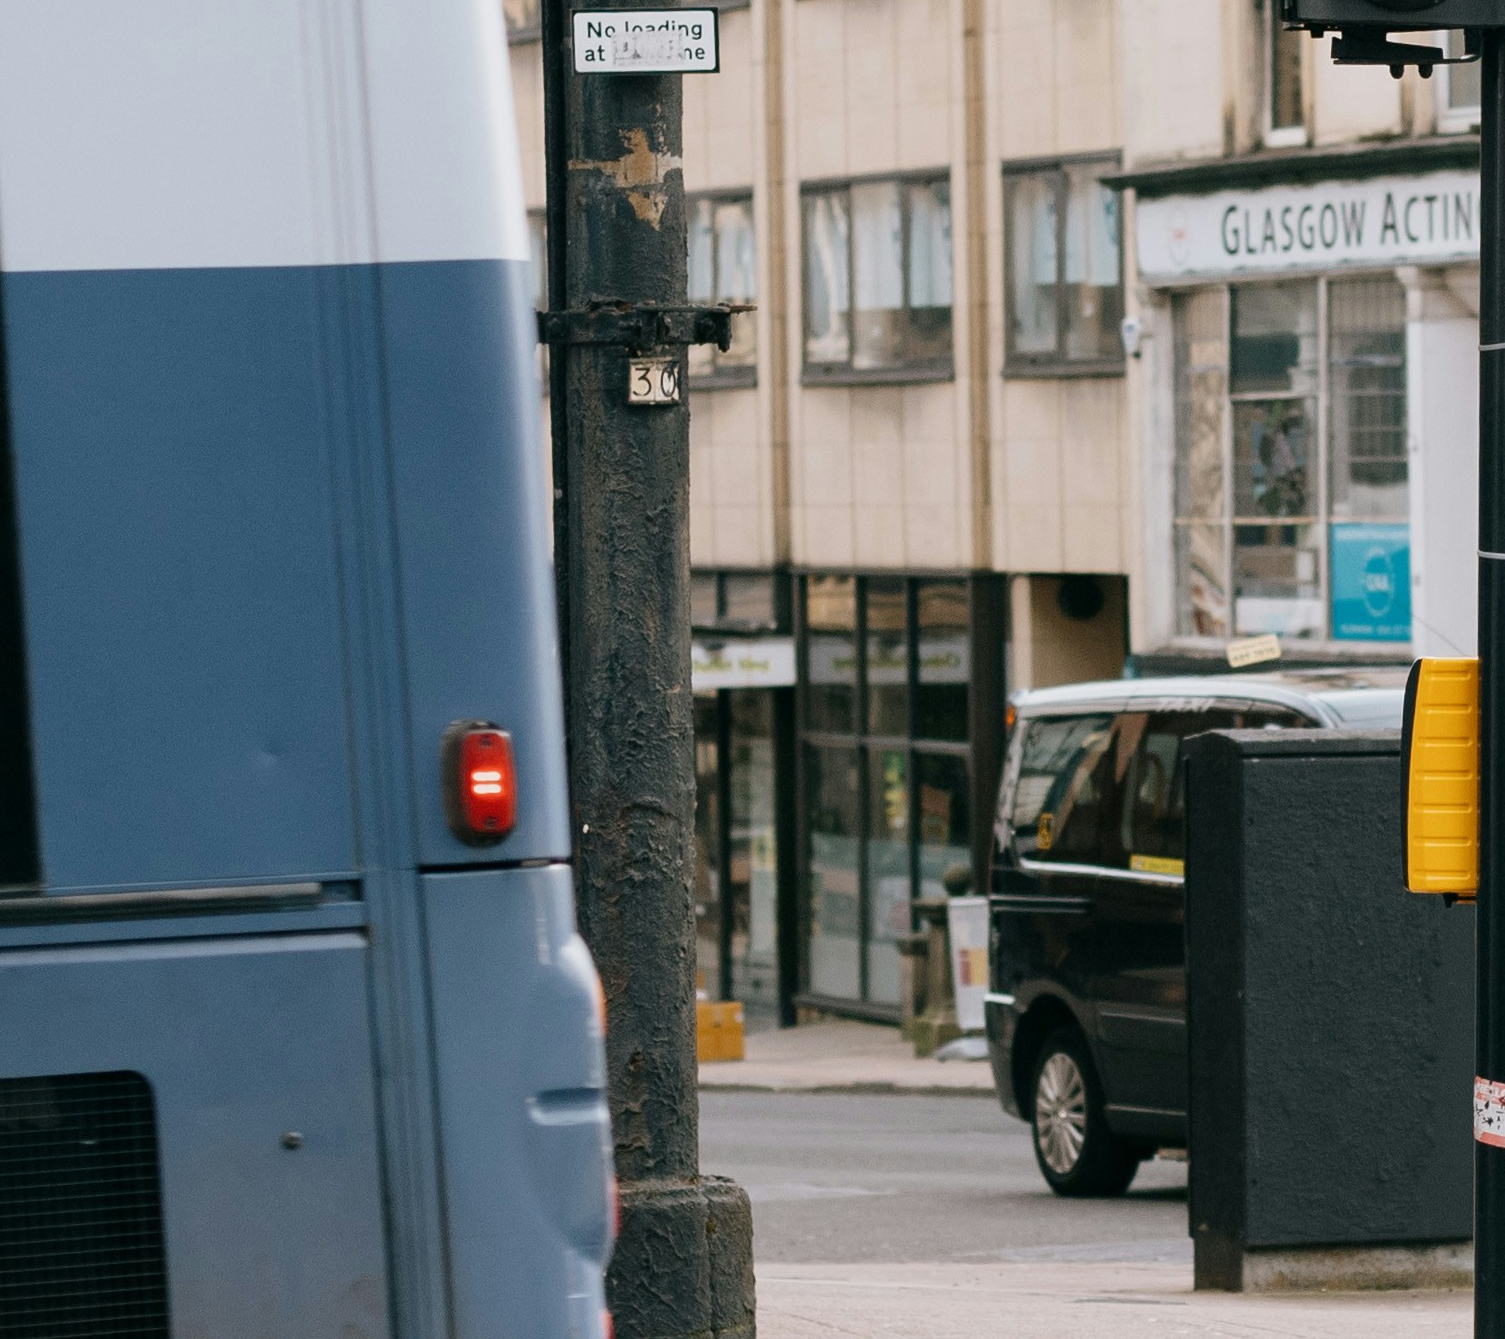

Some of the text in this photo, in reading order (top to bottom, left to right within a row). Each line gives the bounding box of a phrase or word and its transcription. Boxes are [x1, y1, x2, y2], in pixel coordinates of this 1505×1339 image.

[587, 21, 615, 38] No
[585, 45, 605, 61] at
[1221, 200, 1366, 256] GLASGOW
[1381, 192, 1481, 244] ACTIN
[633, 367, 677, 398] 30
